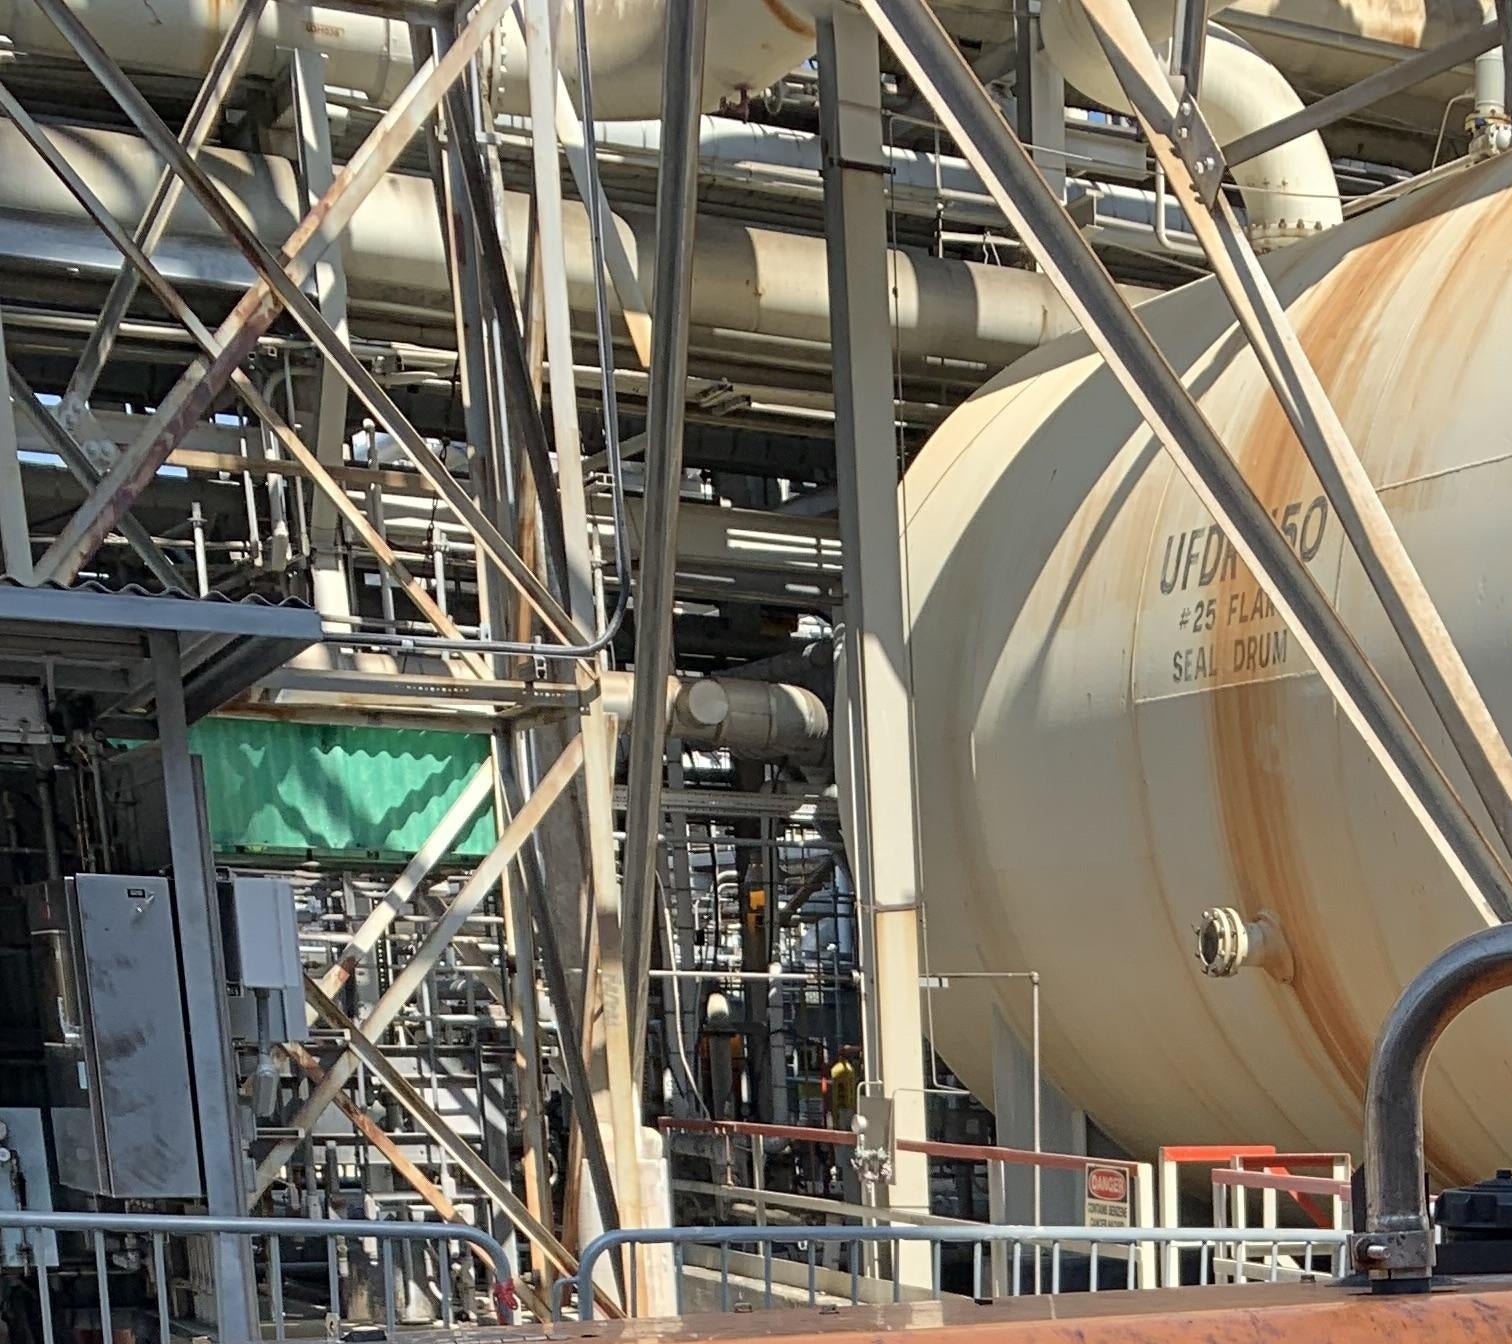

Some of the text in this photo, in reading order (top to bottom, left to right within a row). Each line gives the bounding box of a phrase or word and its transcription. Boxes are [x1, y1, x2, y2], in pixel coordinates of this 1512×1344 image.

[1179, 598, 1217, 634] #25
[1173, 628, 1288, 684] SEAL DRUM
[1091, 1174, 1125, 1193] DANGER
